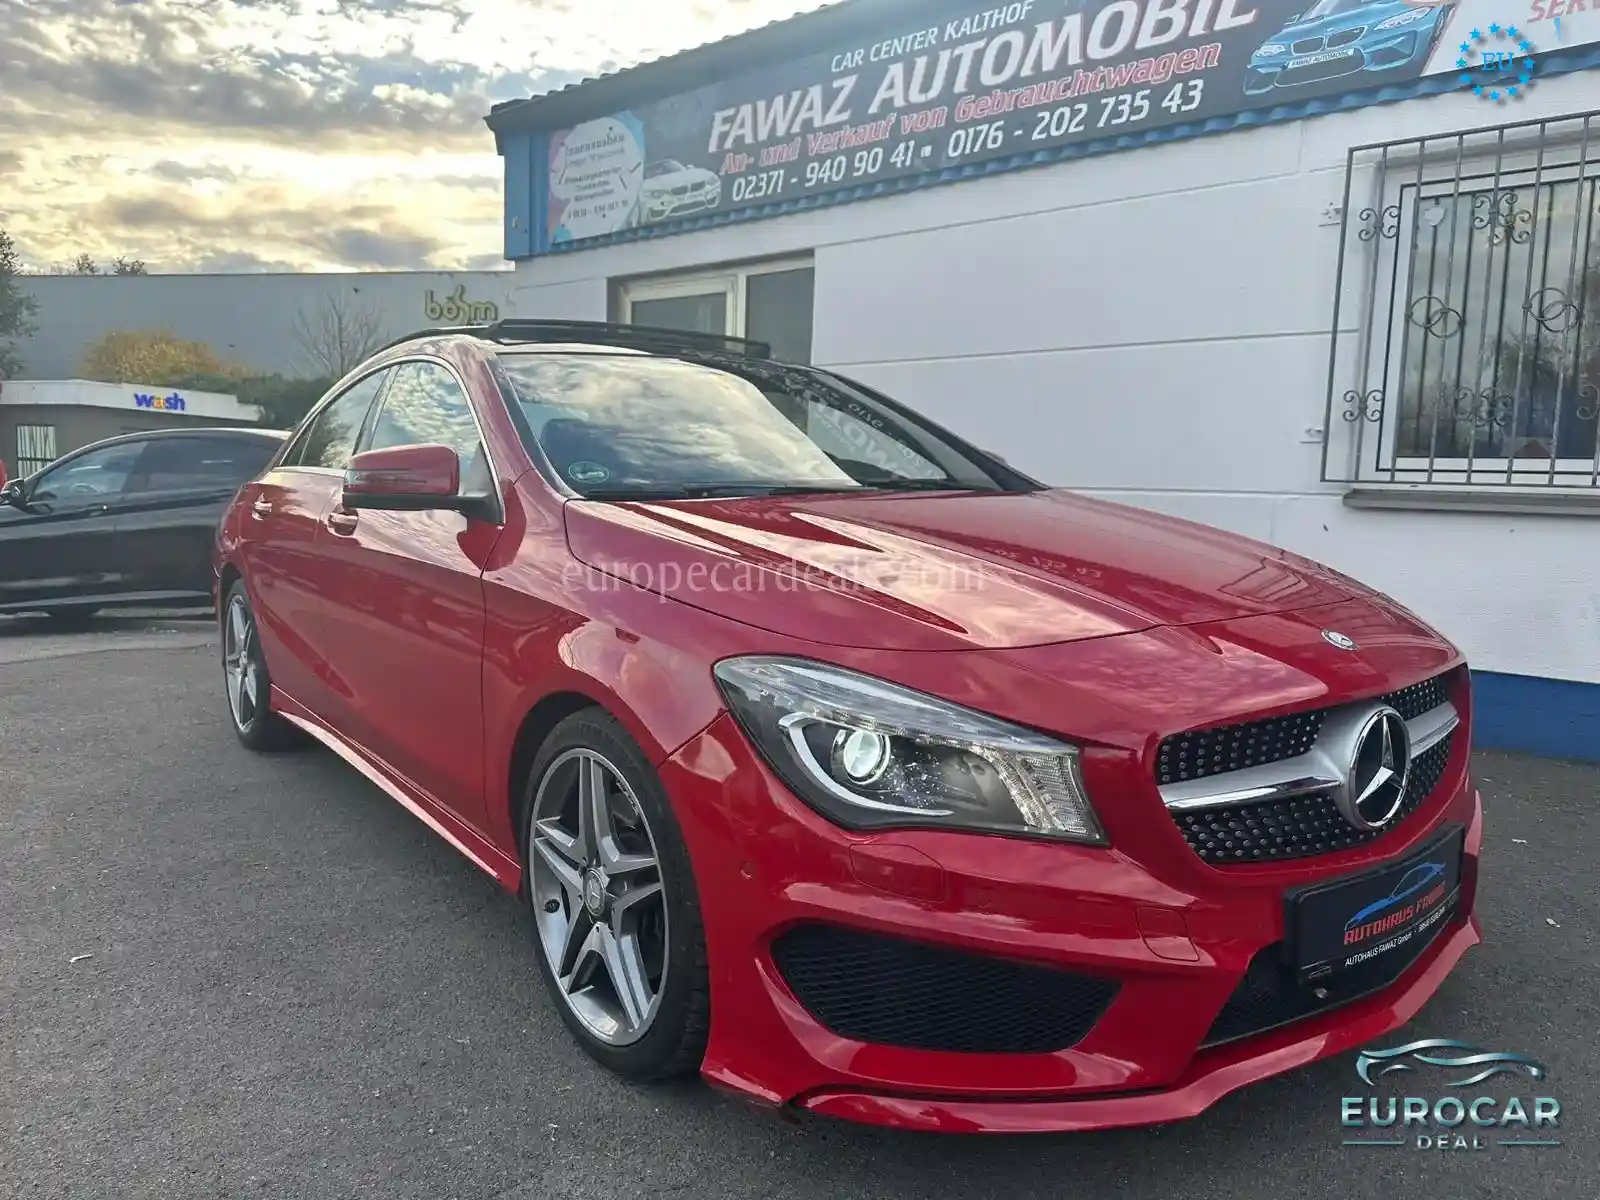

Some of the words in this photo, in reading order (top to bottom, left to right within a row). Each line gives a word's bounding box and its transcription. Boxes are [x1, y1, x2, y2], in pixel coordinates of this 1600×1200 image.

[708, 73, 858, 153] FAWAZ
[867, 0, 1257, 114] AUTOMOBIL
[831, 49, 864, 73] CAR
[869, 27, 938, 62] CENTER
[943, 0, 1034, 42] KALTHOF
[720, 152, 754, 176] An-
[758, 137, 802, 167] und
[807, 112, 897, 156] Verkauf
[900, 106, 948, 135] von
[955, 42, 1222, 123] Gebrauchtwagen
[732, 170, 785, 201] 02371
[805, 155, 847, 187] 940
[853, 148, 883, 177] 90
[890, 140, 915, 168] 41
[948, 120, 1004, 158] 0176
[1031, 103, 1088, 141] 202
[1097, 89, 1151, 128] 735
[1161, 78, 1204, 113] 43
[1344, 904, 1413, 945] AUTOHAUS
[1345, 946, 1379, 967] AUTOHAUS
[1379, 938, 1397, 955] FAWAZ
